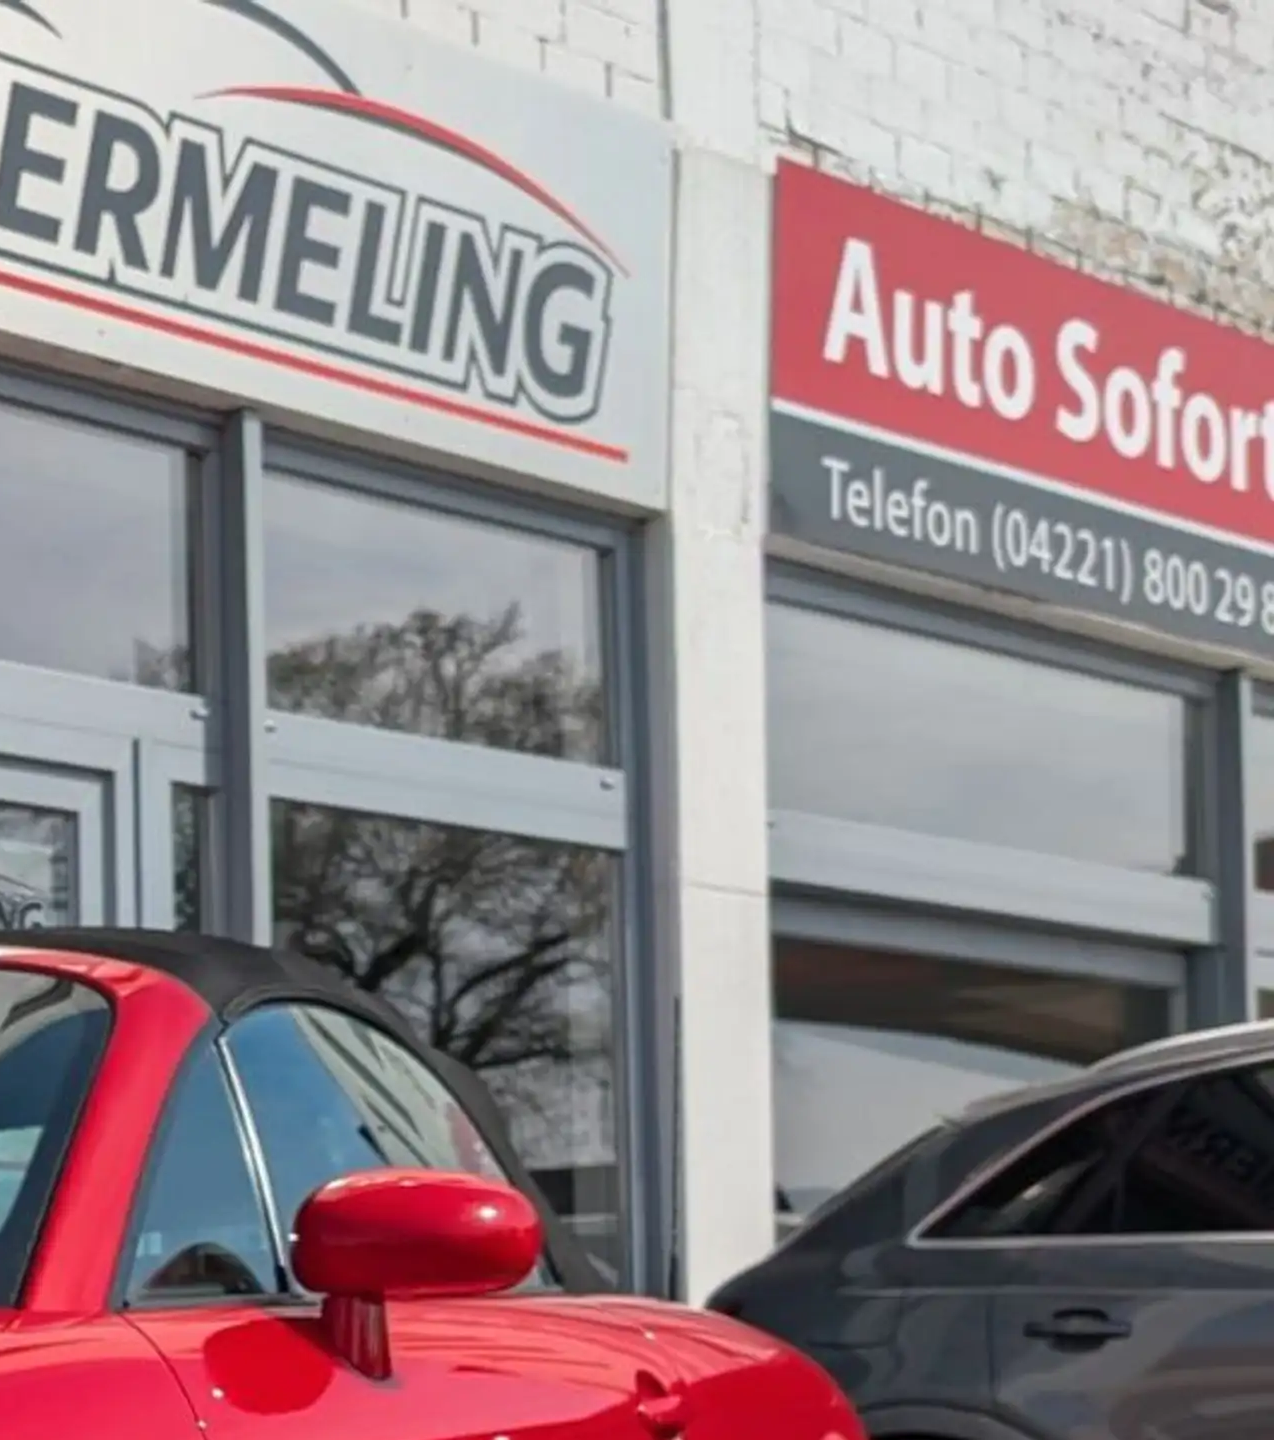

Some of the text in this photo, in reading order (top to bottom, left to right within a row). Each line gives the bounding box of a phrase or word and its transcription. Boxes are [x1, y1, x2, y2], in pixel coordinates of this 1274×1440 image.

[822, 236, 1036, 422] Auto
[821, 455, 979, 555] Telefon
[991, 501, 1134, 606] (04221)
[1143, 548, 1209, 616] 800
